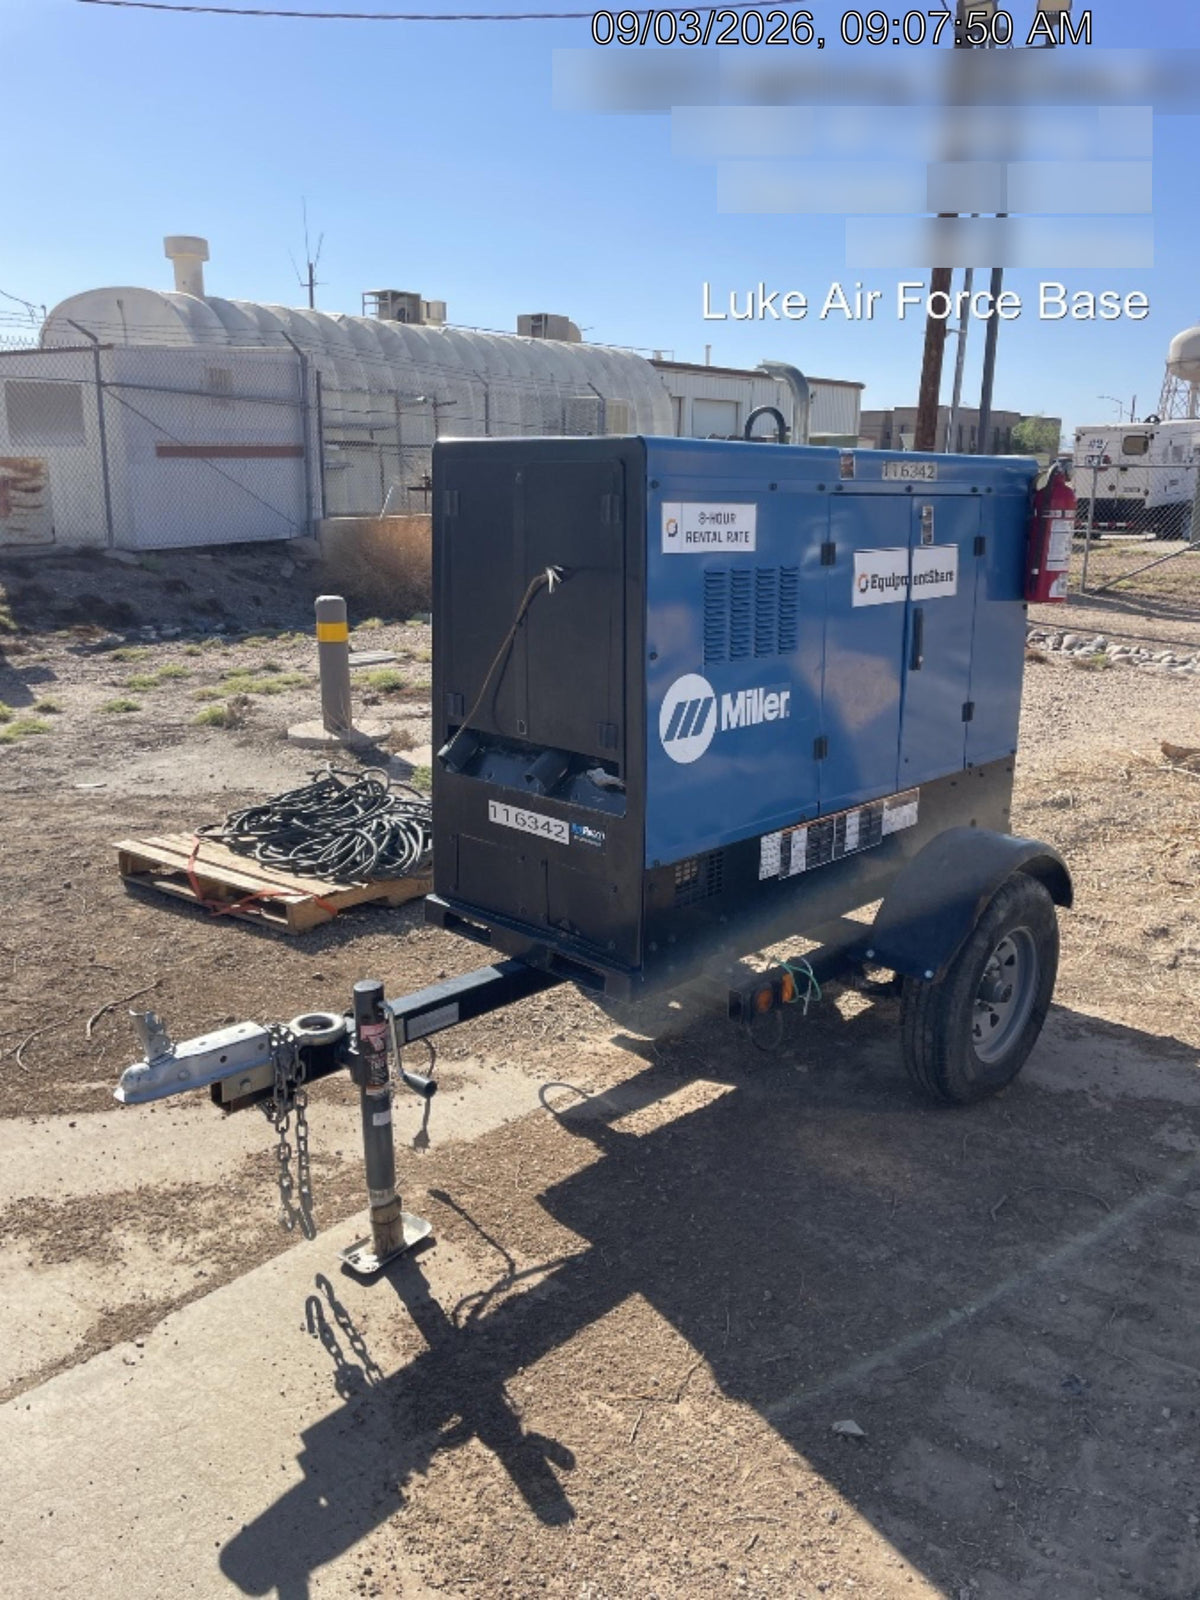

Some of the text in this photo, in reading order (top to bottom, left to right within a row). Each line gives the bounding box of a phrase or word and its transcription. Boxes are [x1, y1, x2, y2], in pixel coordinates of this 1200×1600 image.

[881, 463, 935, 480] 116342
[697, 511, 737, 526] 8-HOUR
[685, 530, 750, 544] RENTAL RATE
[721, 688, 790, 732] Miller
[489, 804, 567, 840] 116342
